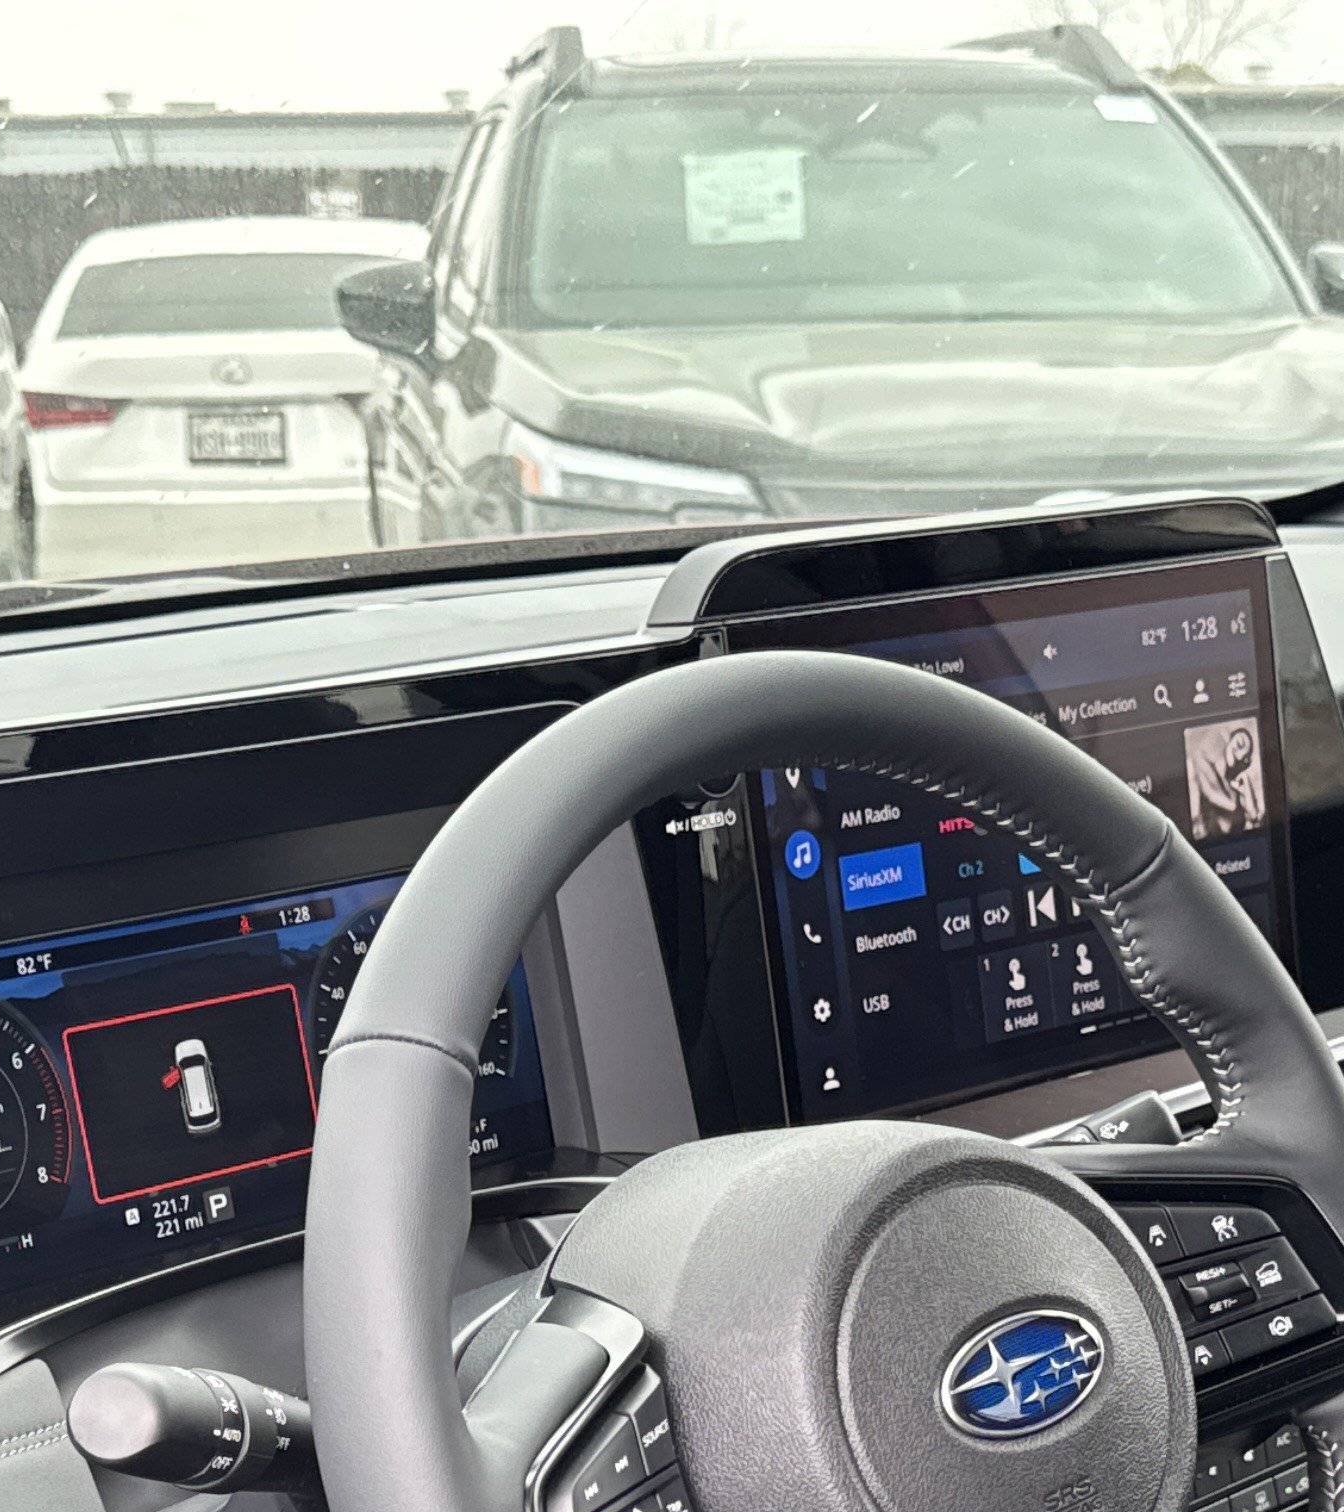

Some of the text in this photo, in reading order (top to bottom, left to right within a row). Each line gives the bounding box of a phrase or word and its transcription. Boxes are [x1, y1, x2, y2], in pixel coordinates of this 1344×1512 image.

[1181, 615, 1218, 642] 1:28
[1058, 704, 1078, 726] My
[1079, 697, 1138, 720] Collection
[841, 803, 902, 829] AM Radio
[958, 860, 985, 878] Ch 2
[847, 866, 903, 892] SiriusXM
[279, 906, 311, 926] 1:28
[855, 925, 918, 953] Bluetooth
[1051, 943, 1060, 958] 2
[983, 957, 991, 972] 1
[331, 986, 346, 1001] 40
[1072, 978, 1101, 995] Press
[862, 994, 891, 1014] USB
[1005, 994, 1034, 1011] Press
[1071, 996, 1105, 1016] & Hold
[1003, 1012, 1039, 1033] & Hold
[11, 1051, 24, 1070] 6
[477, 1061, 496, 1076] 160
[36, 1103, 47, 1121] 7
[37, 1166, 49, 1184] 8
[152, 1194, 190, 1219] 221.7
[209, 1193, 228, 1219] P
[155, 1211, 204, 1239] 221 mi
[21, 1233, 34, 1249] H
[211, 1456, 234, 1470] OFF
